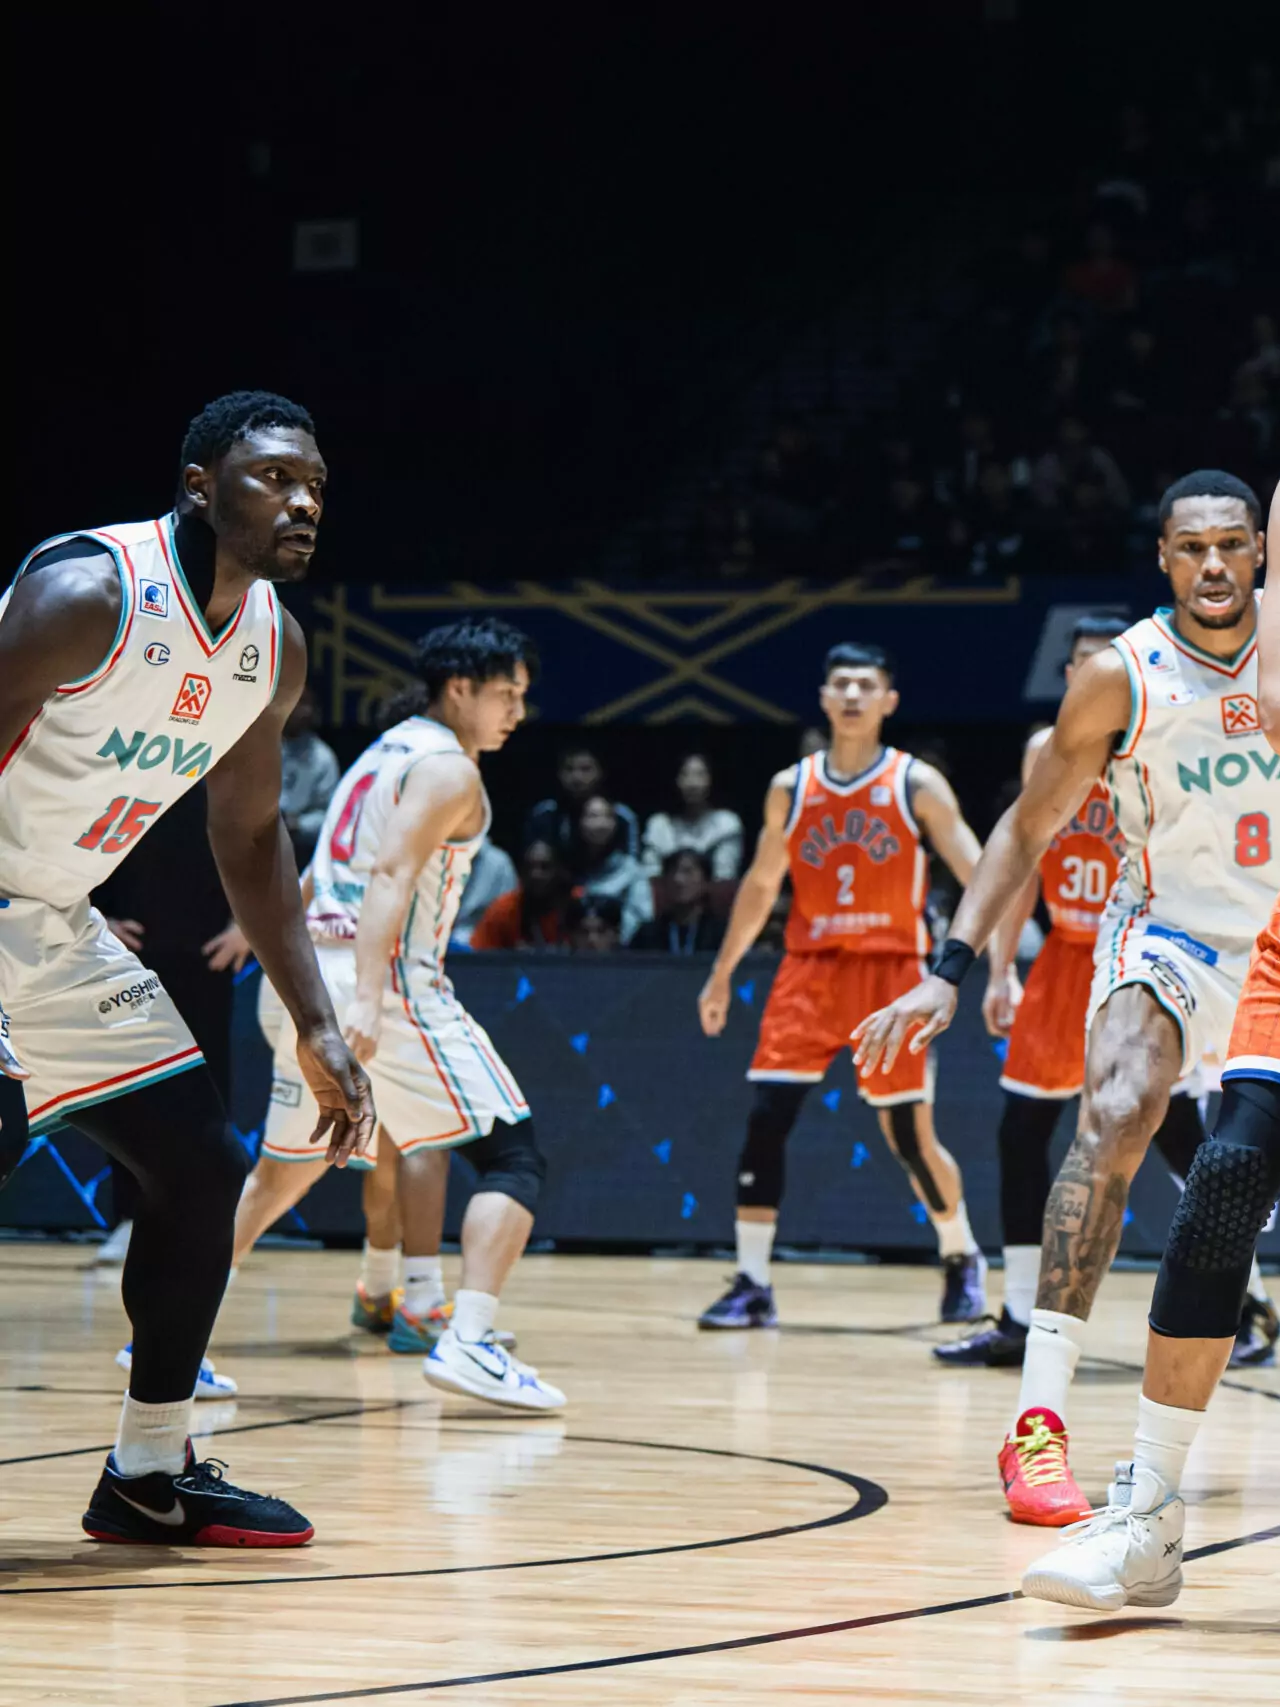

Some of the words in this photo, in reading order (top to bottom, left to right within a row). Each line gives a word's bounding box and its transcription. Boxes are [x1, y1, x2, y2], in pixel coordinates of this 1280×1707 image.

[144, 602, 165, 613] EASL
[96, 726, 213, 778] NOVA
[73, 795, 163, 854] 15
[800, 808, 901, 870] PILOTS
[1234, 811, 1272, 868] 8
[836, 863, 855, 906] 2
[1058, 855, 1107, 903] 30
[108, 976, 160, 1008] YOSHIN
